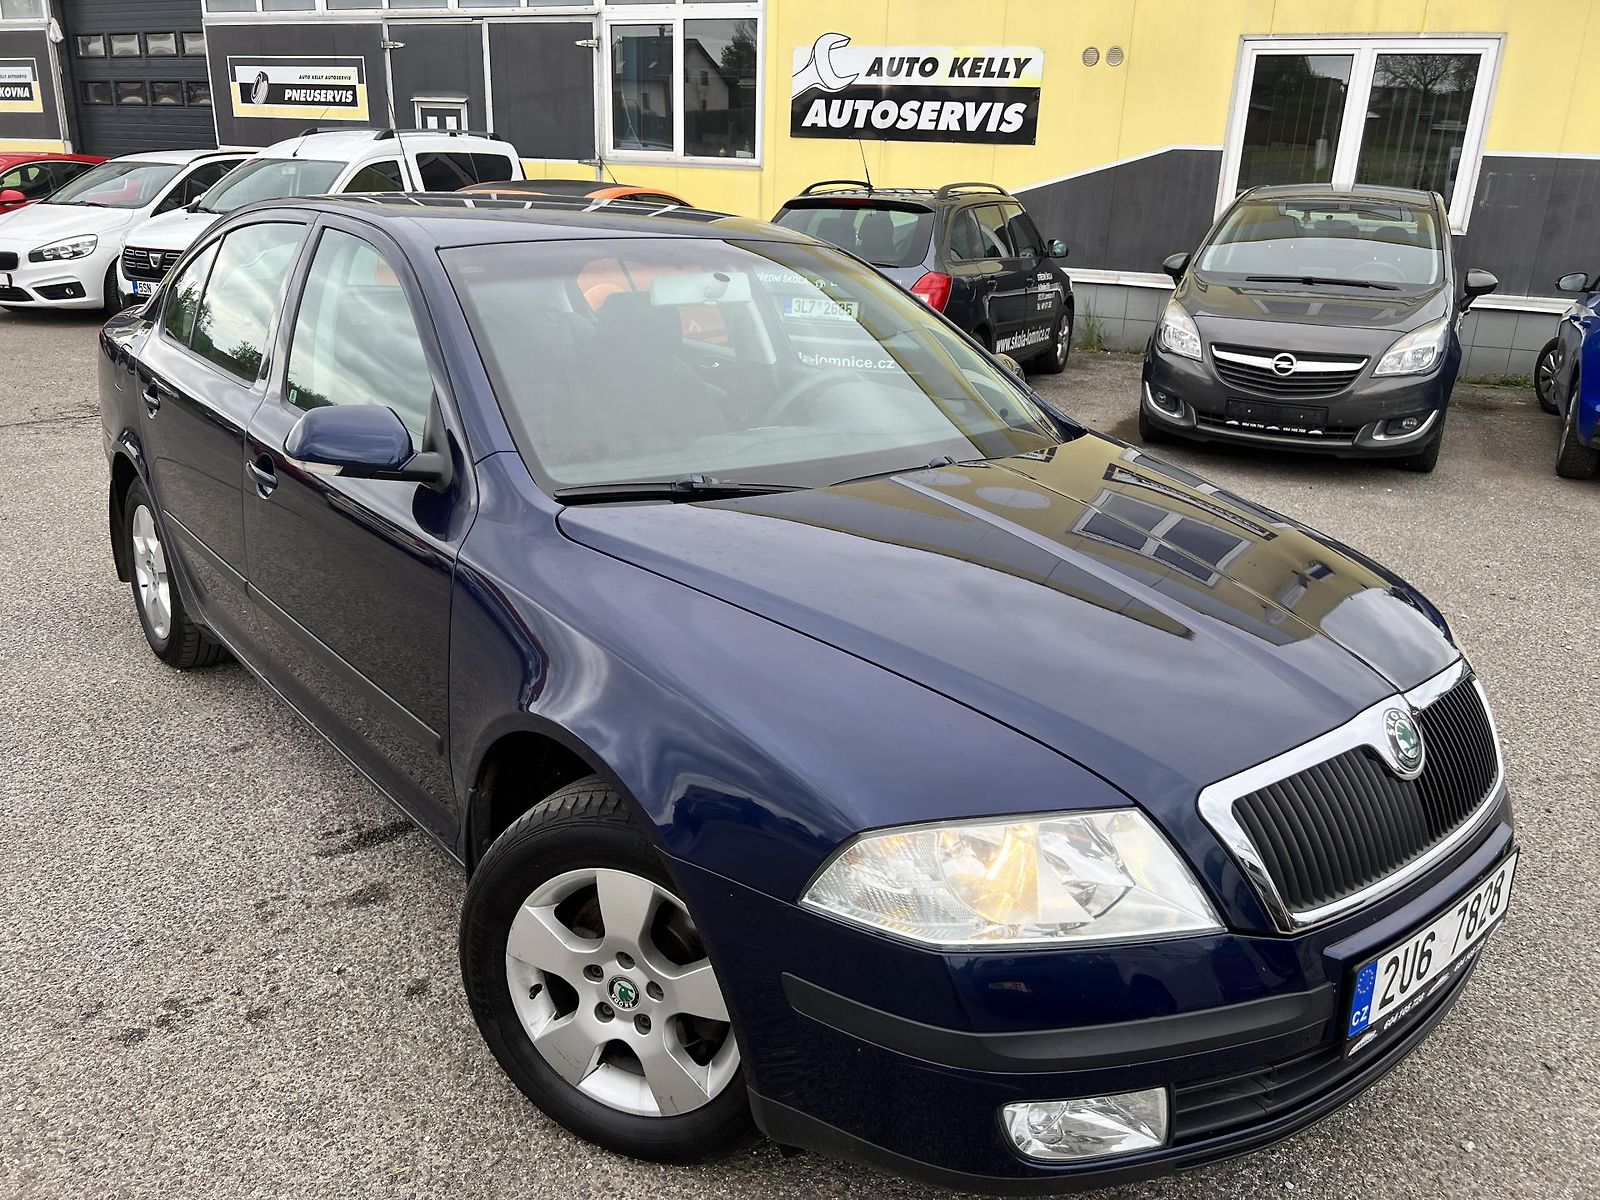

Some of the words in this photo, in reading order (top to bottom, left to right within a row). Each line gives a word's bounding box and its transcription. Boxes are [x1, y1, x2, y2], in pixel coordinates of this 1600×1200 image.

[865, 57, 939, 77] AUTO
[948, 57, 1032, 79] KELLY
[284, 89, 353, 102] PNEUSERVIS
[802, 99, 1027, 133] AUTOSERVIS
[794, 299, 815, 313] 3L7
[1378, 931, 1435, 1010] 2U6
[1451, 870, 1505, 955] 7828
[1351, 1005, 1369, 1027] CZ
